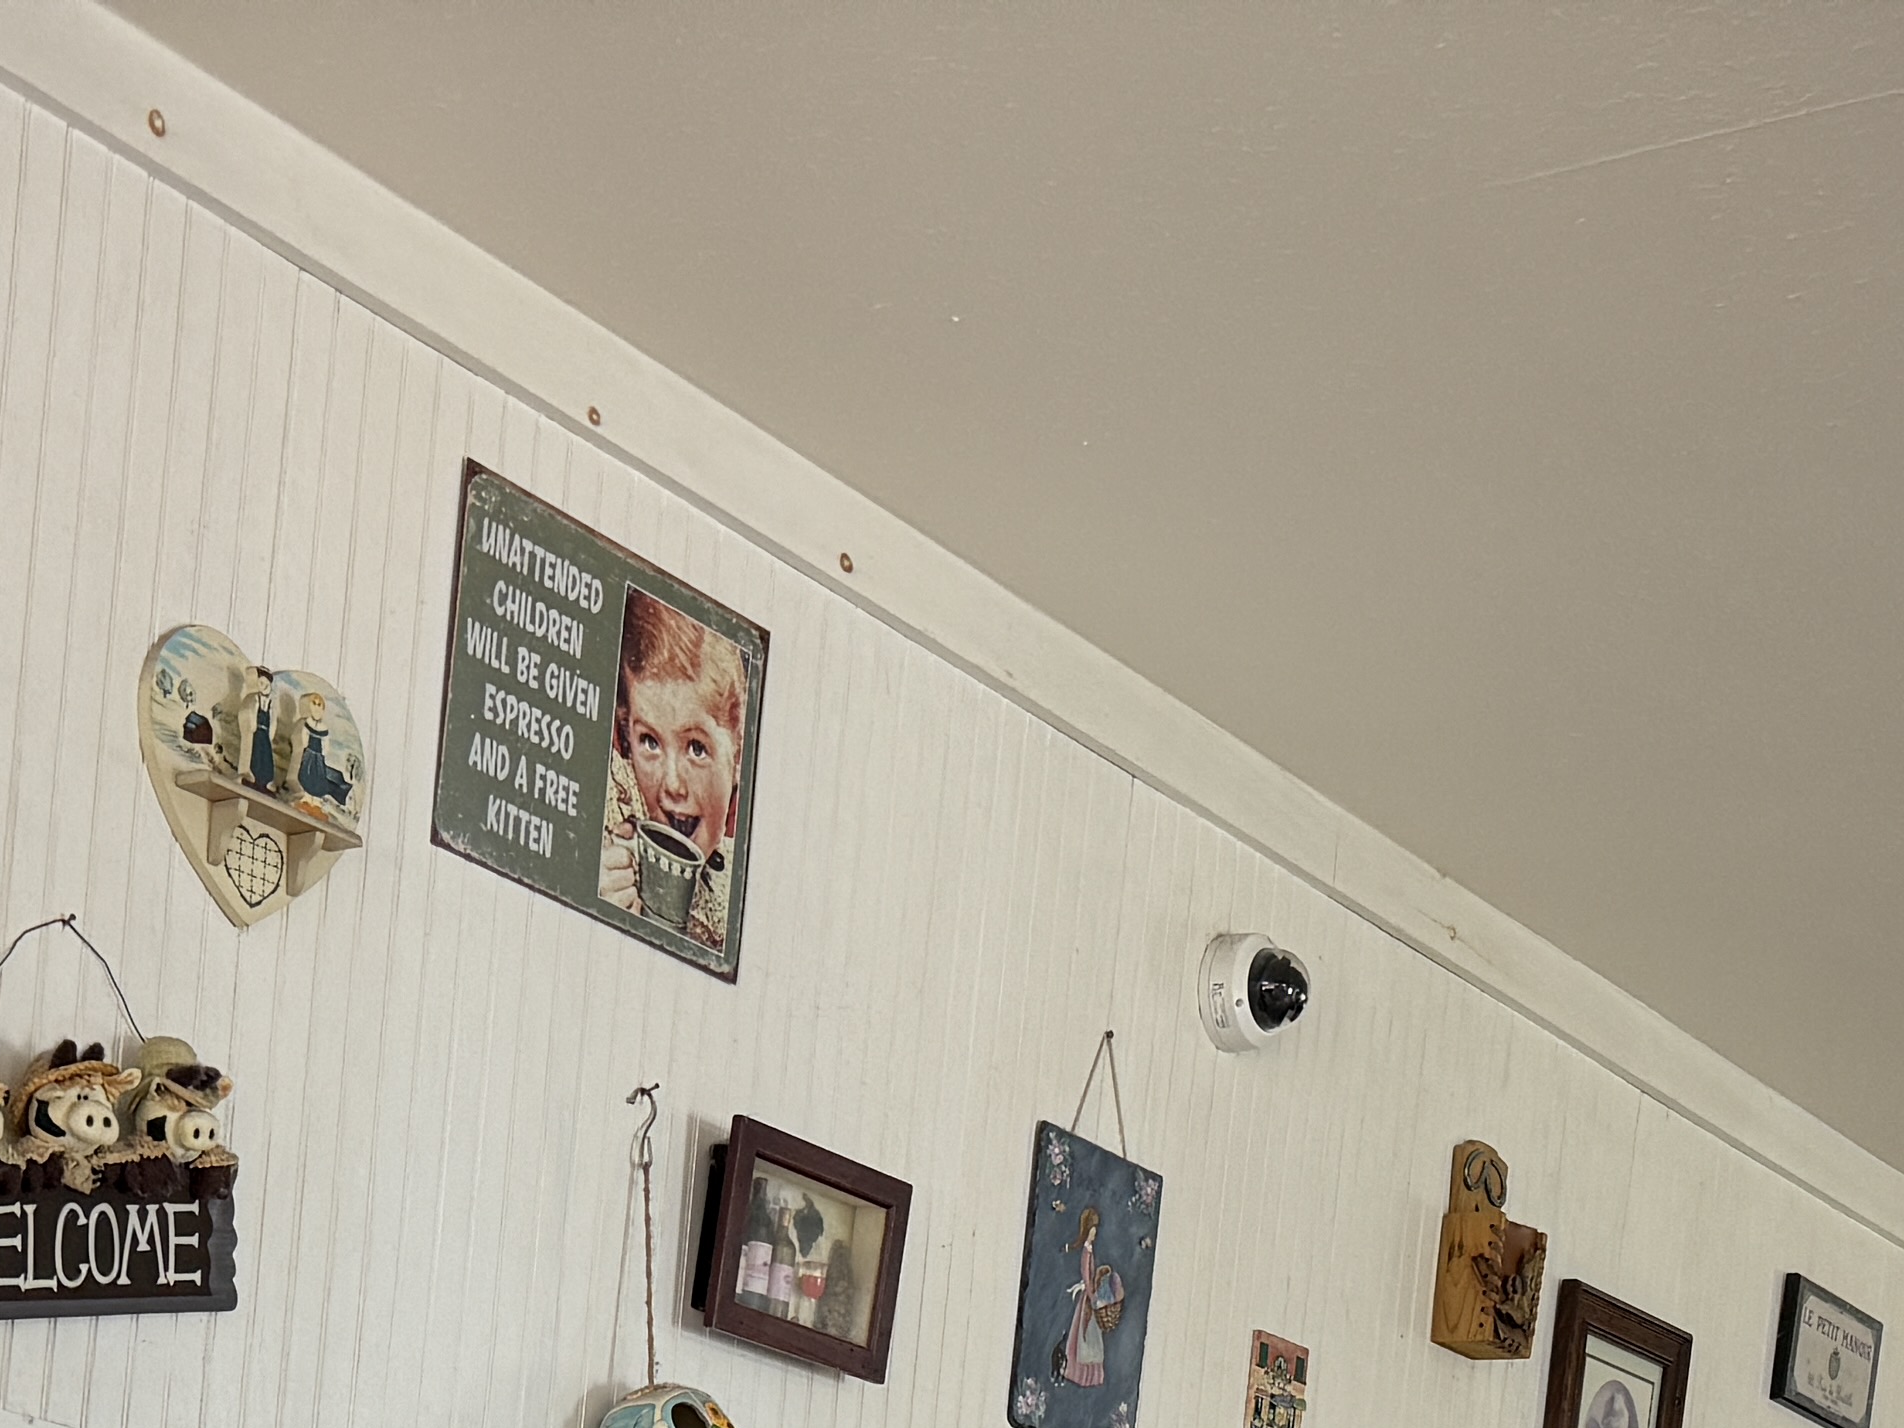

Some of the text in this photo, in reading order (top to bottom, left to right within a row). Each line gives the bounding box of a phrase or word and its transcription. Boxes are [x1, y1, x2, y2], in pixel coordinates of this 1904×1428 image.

[482, 517, 604, 615] UNATTENDED
[492, 582, 584, 660] CHILDREN
[466, 617, 601, 722] WILL BE GIVEN
[483, 682, 575, 760] ESPRESSO
[468, 732, 580, 817] AND A FREE
[485, 794, 554, 859] KITTEN
[1802, 1306, 1813, 1328] LE
[1816, 1315, 1840, 1342] PETIT
